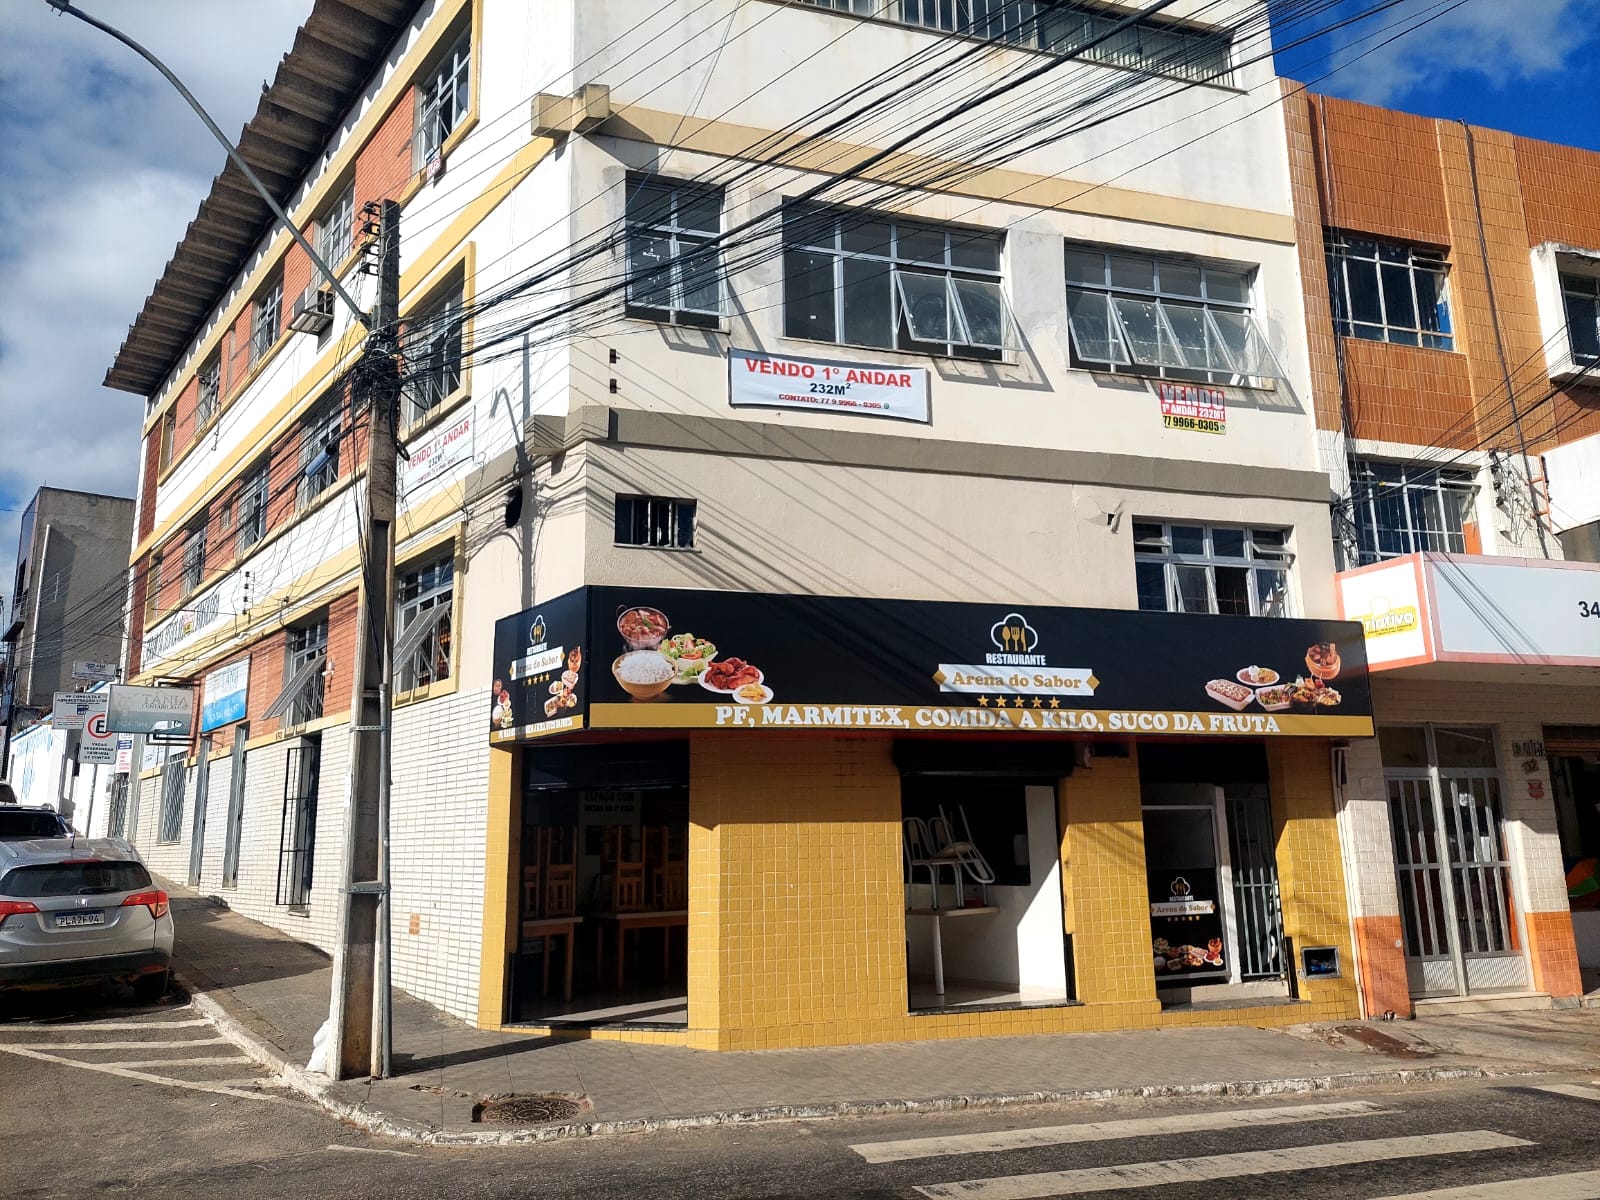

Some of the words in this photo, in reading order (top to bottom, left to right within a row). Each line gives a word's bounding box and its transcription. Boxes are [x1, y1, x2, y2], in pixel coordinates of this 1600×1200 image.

[745, 358, 815, 379] VENDO
[846, 369, 912, 388] ANDAR
[810, 382, 852, 396] 232M²
[778, 394, 819, 404] CONTATO:
[863, 400, 882, 409] 0305
[1162, 384, 1224, 410] VENDO
[1170, 404, 1198, 416] ANDAR
[1174, 416, 1220, 431] 9966-0305
[408, 446, 432, 470] VENDO
[443, 420, 470, 446] ANDAR
[541, 656, 559, 667] Sabor
[985, 653, 1046, 666] RESTAURANTE
[952, 672, 1004, 686] Arena
[1008, 674, 1029, 687] do
[1034, 674, 1082, 688] Sabor
[142, 692, 188, 706] TÂNIA
[716, 706, 755, 728] PF,
[756, 706, 910, 728] MARMITEX,
[915, 708, 1015, 728] COMIDA
[1018, 710, 1037, 728] A
[1040, 710, 1104, 732] KILO,
[1108, 712, 1168, 732] SUCO
[1172, 713, 1204, 732] DA
[1208, 714, 1280, 732] FRUTA
